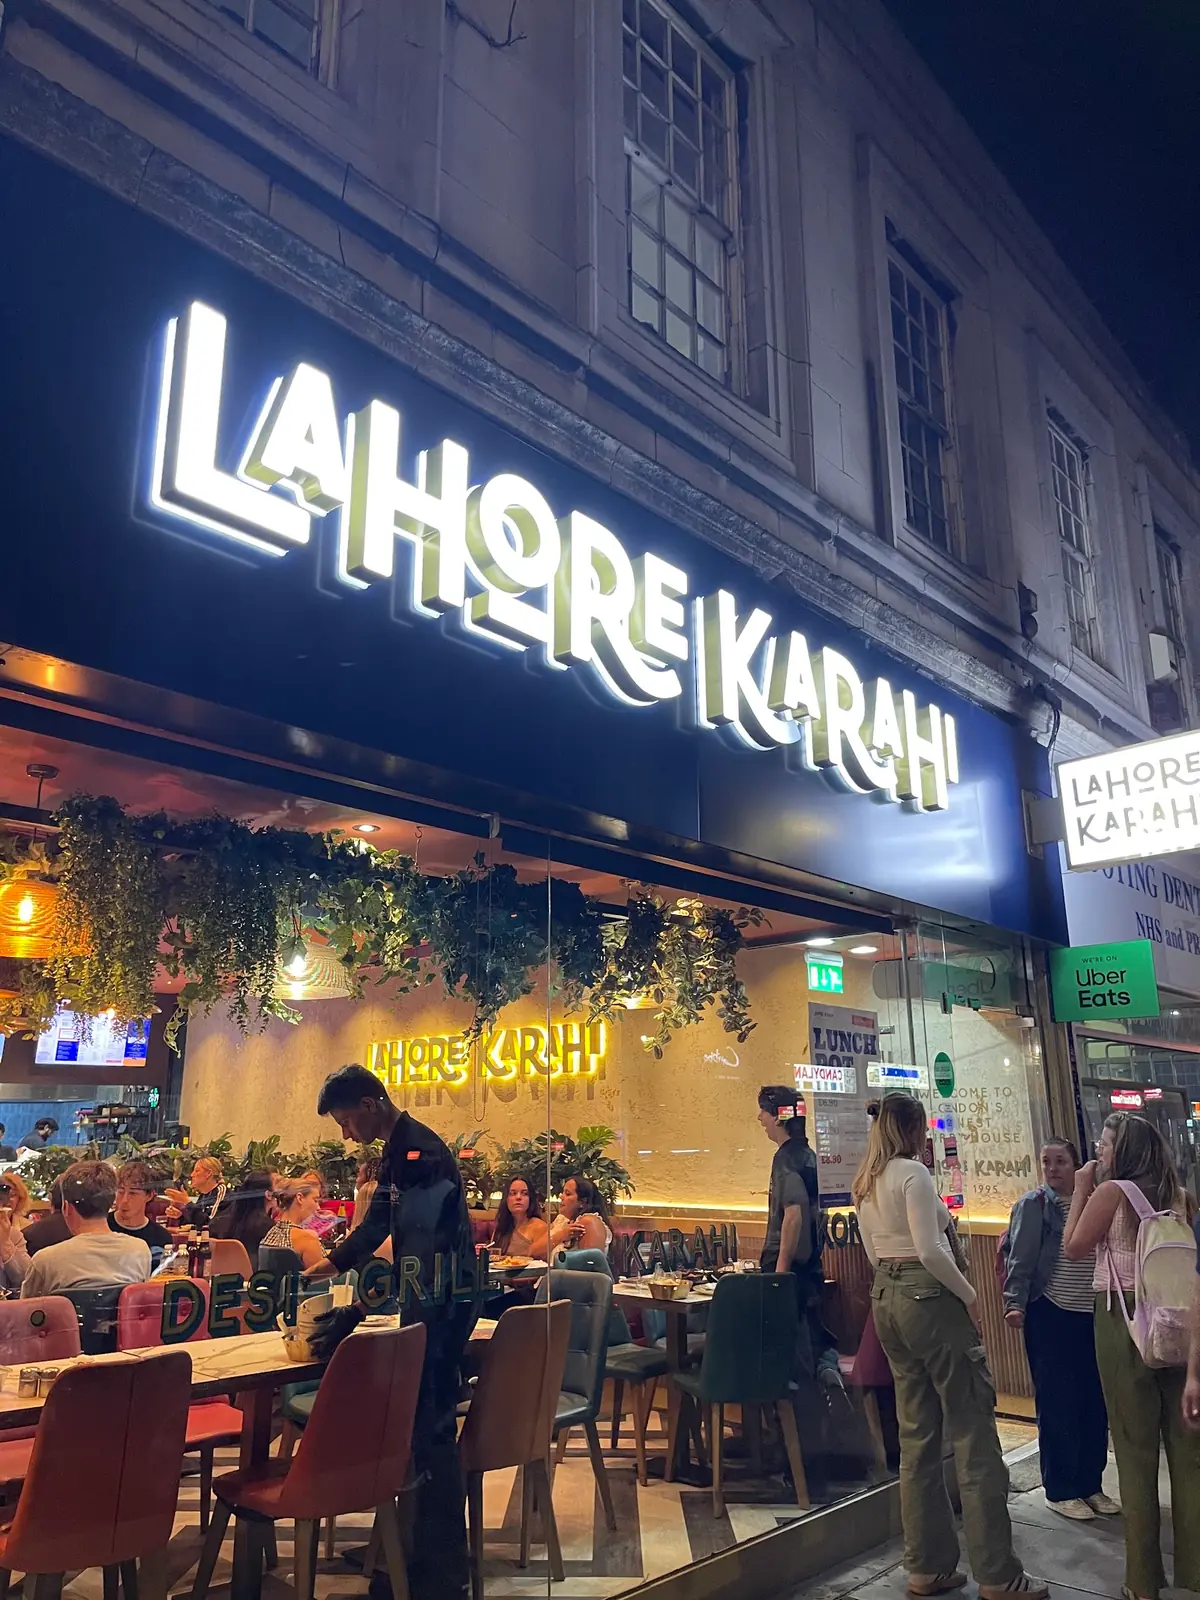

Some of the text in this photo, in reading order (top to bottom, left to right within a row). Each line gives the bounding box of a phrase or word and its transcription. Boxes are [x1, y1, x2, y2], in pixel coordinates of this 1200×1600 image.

[152, 300, 959, 813] LAHORE KARAHI
[1072, 751, 1200, 807] LAHORE
[1077, 794, 1200, 847] KARAH
[1135, 910, 1163, 944] NHS
[1164, 927, 1185, 951] and
[1075, 968, 1127, 987] Uber
[1081, 956, 1104, 964] WE'RE
[1078, 989, 1131, 1008] Eats
[366, 1020, 602, 1084] LAHORE KARAHI
[813, 1027, 877, 1056] LUNCH
[919, 1086, 1013, 1099] WECOME TO
[621, 1223, 737, 1277] KARAHI
[160, 1247, 501, 1345] DESI GRILL
